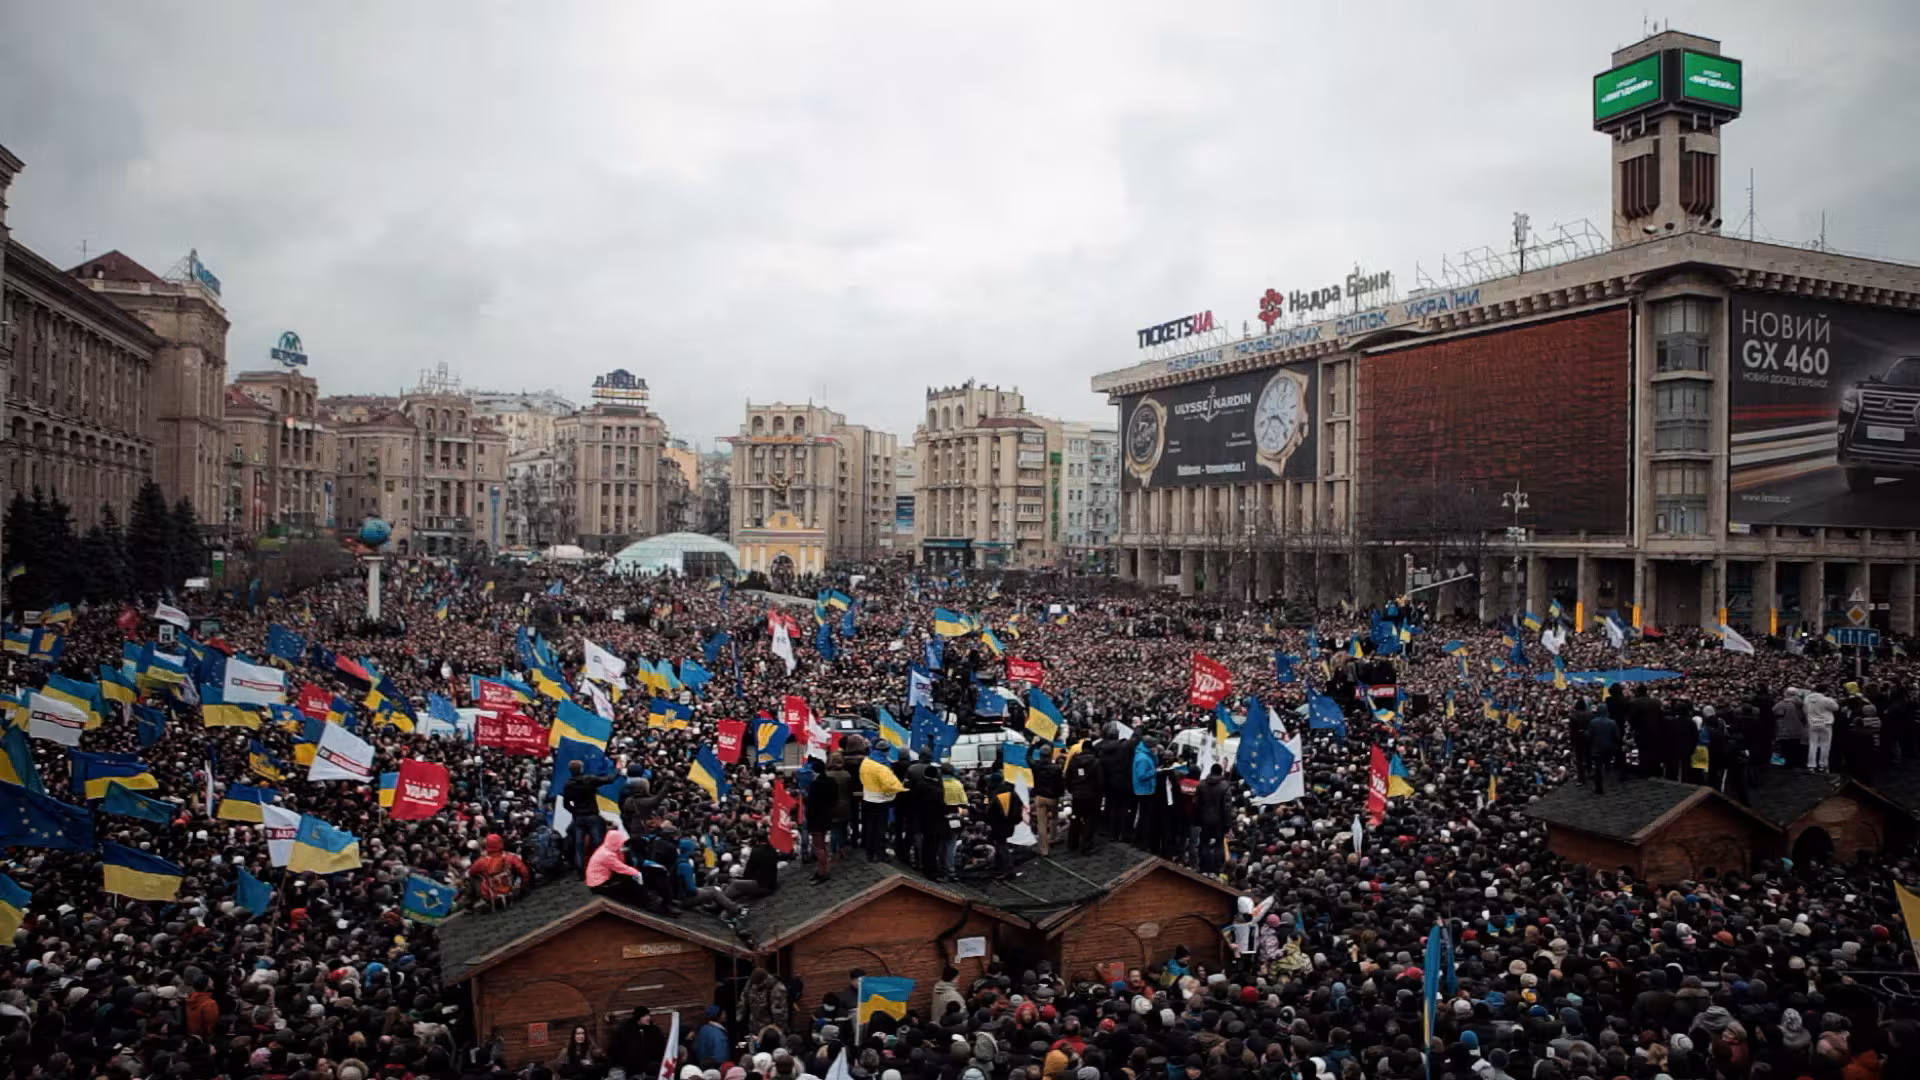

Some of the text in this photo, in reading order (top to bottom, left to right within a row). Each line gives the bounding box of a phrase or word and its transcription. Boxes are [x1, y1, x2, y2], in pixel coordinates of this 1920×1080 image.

[1288, 270, 1391, 313] Надра Банк
[1335, 309, 1390, 336] СПІЛОК
[1404, 287, 1481, 320] УКРАЇНИ
[1742, 308, 1830, 344] НОВИЙ
[1742, 339, 1830, 376] GX 460
[1174, 392, 1252, 415] ULYSSE NARDIN
